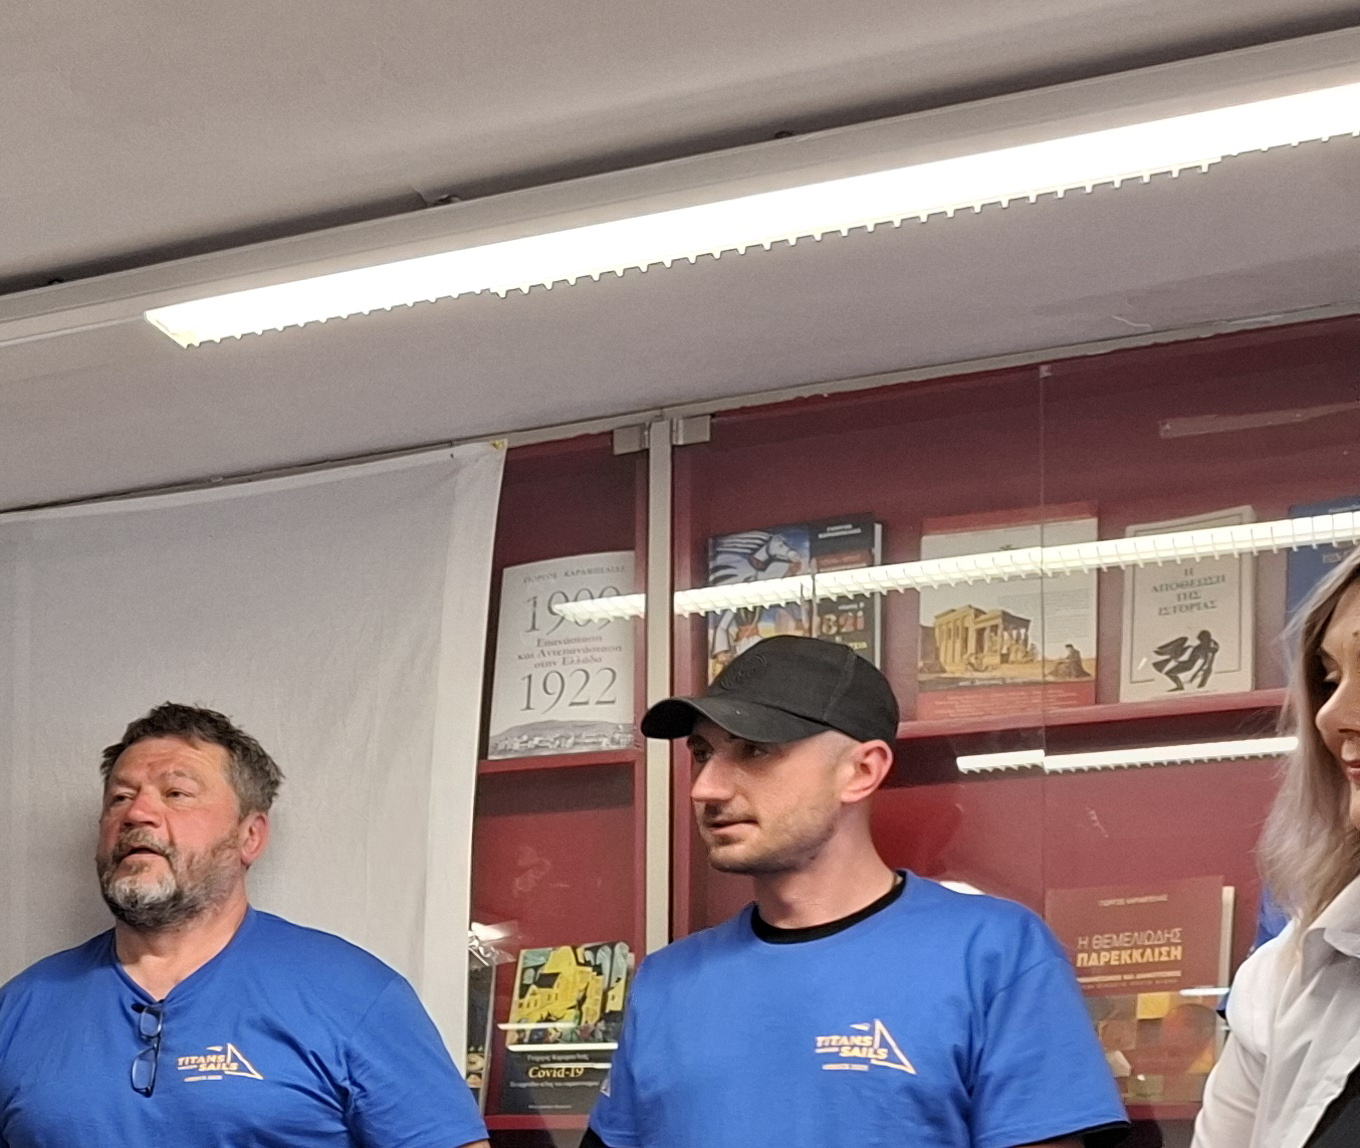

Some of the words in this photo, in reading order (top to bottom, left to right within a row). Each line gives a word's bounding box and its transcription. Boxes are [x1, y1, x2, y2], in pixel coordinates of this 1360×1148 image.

[520, 667, 617, 715] 1922
[1077, 936, 1089, 950] Η
[1092, 927, 1183, 950] ΘΕΜΕΛΙΩΔΗΣ
[1076, 945, 1183, 968] ΠΑΡΕΚΚΛΙΣΗ
[815, 1035, 873, 1047] TITANS
[839, 1046, 888, 1059] SAILS
[177, 1054, 225, 1066] TITANS
[198, 1062, 239, 1072] SAILS
[528, 1066, 584, 1079] Covid-19
